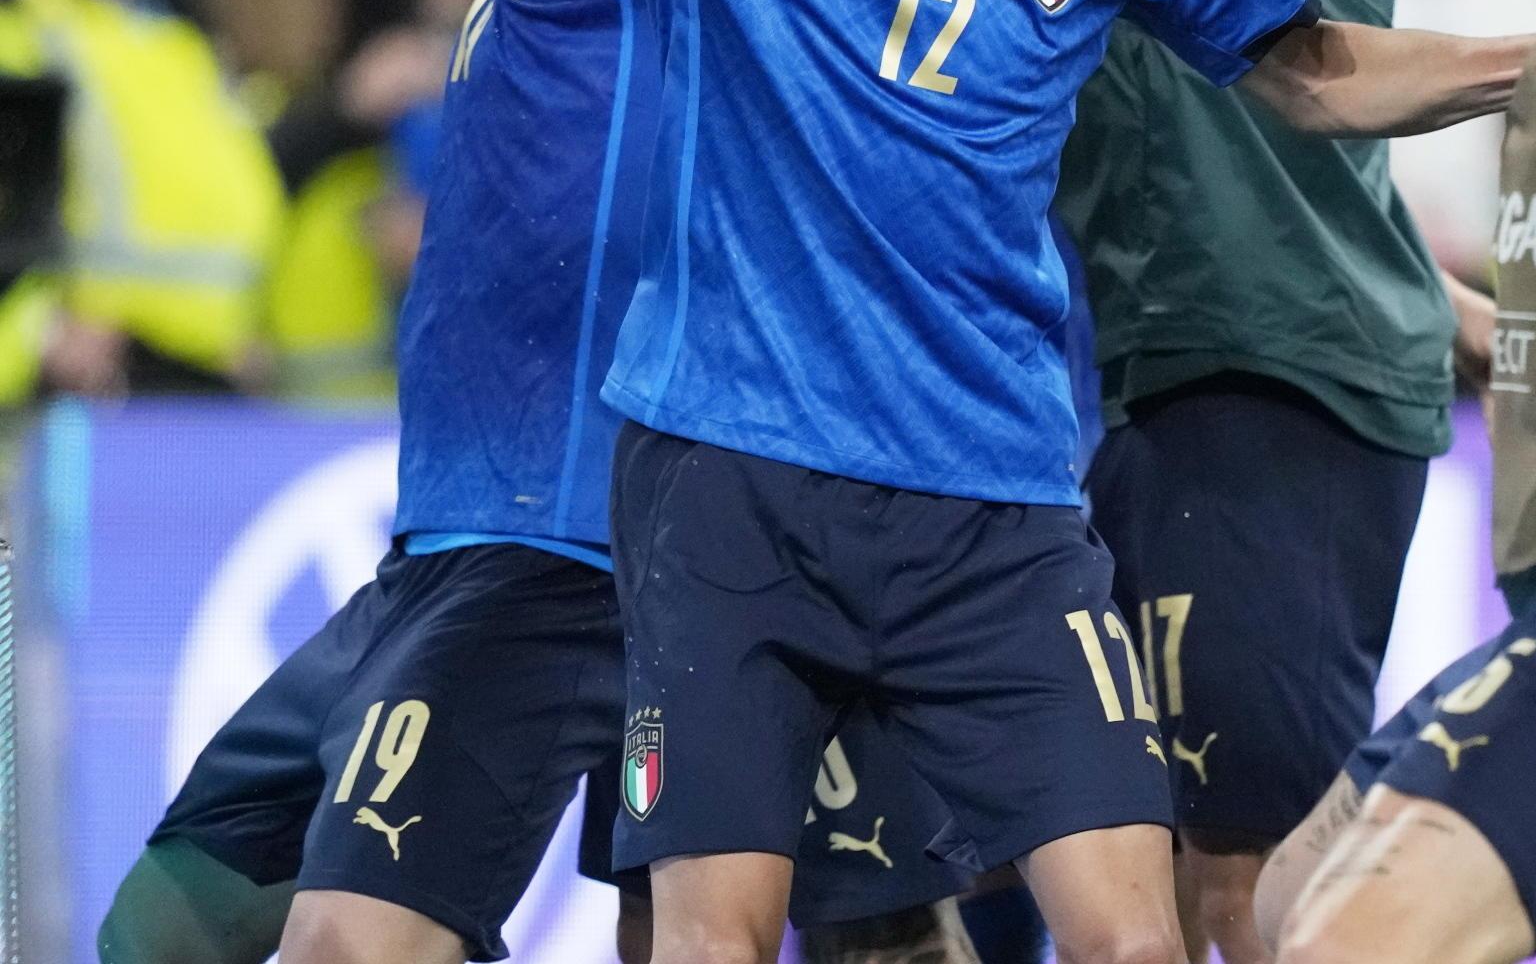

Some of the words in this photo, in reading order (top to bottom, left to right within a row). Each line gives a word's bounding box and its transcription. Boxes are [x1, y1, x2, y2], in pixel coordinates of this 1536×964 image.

[1064, 609, 1158, 725] 12
[332, 699, 431, 804] 19
[628, 730, 660, 752] ITALIA
